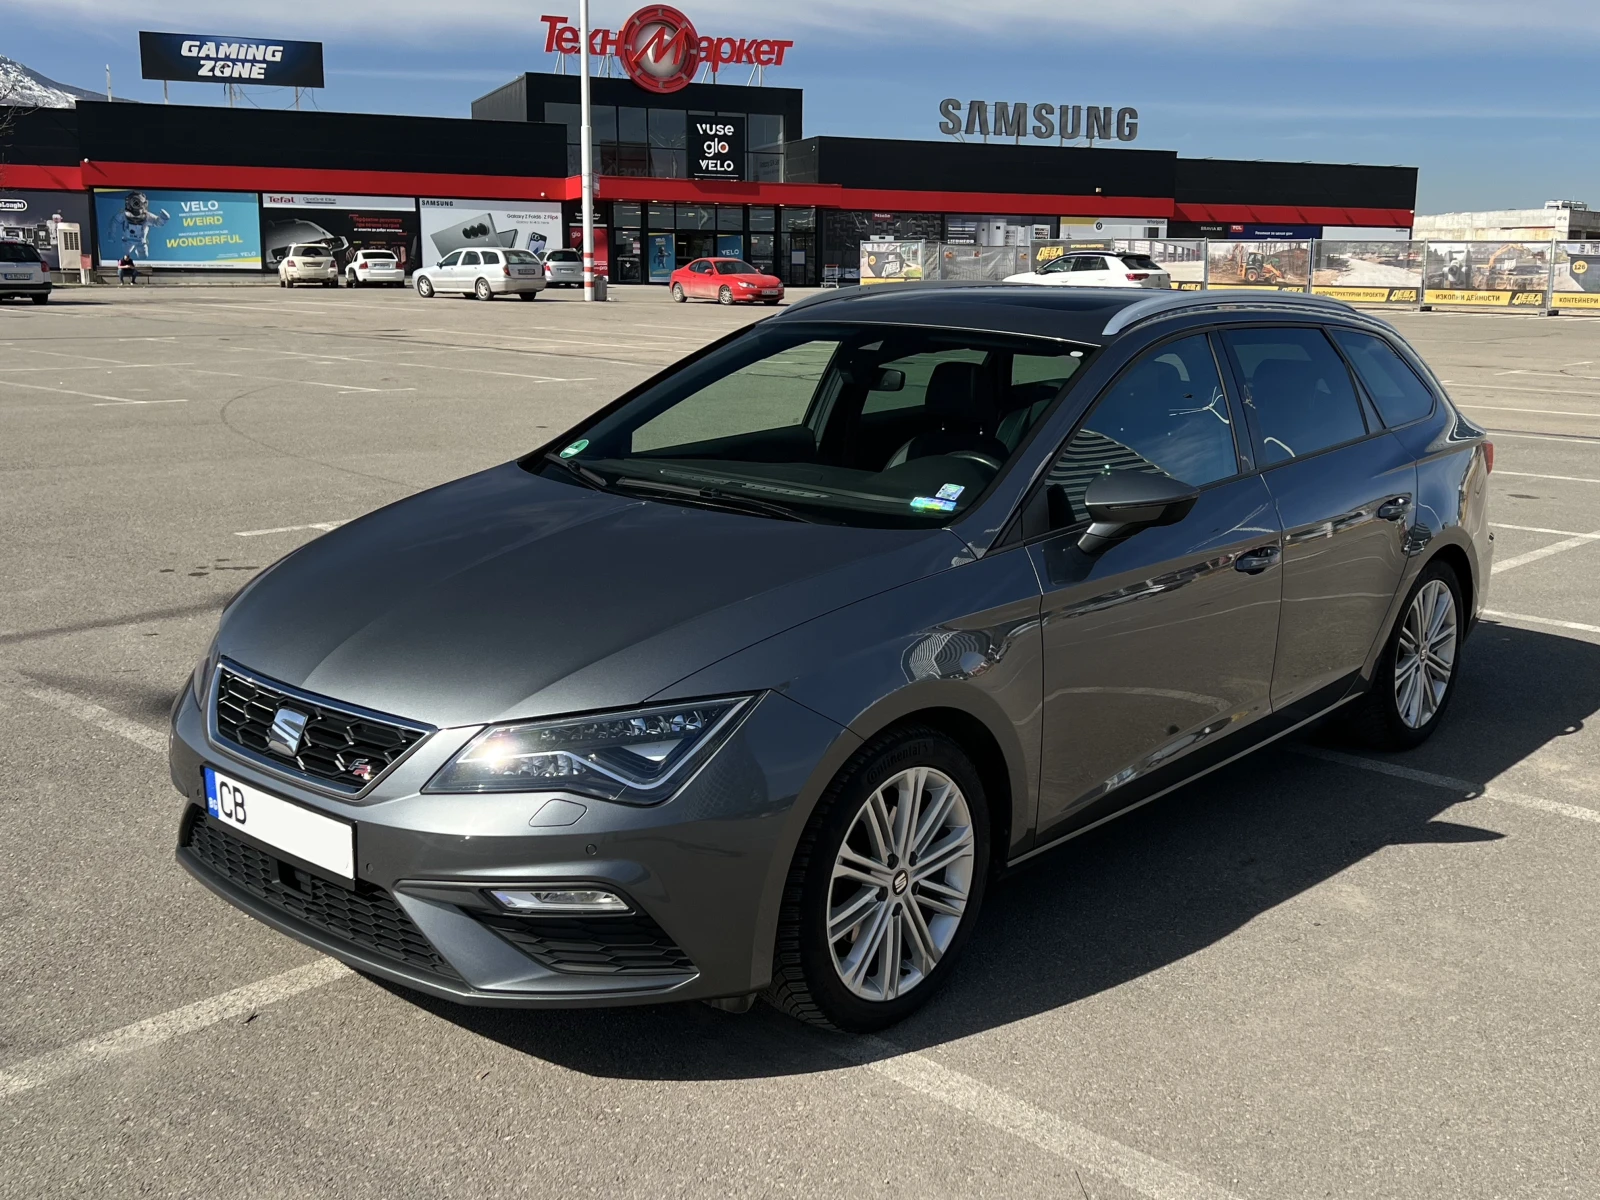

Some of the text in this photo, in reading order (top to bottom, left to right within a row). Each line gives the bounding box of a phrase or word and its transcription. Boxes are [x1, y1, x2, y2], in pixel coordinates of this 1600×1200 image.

[181, 40, 284, 62] GAMING
[197, 60, 267, 79] ZONE
[939, 98, 1138, 142] SAMSUNG
[696, 123, 735, 136] vuse
[703, 137, 729, 157] glo
[699, 159, 734, 171] VELO
[267, 195, 296, 204] Tefal
[421, 199, 454, 207] SAMSUNG
[181, 200, 218, 213] VELO
[183, 215, 223, 227] WEIRD
[166, 234, 243, 248] WONDERFUL
[1559, 296, 1599, 304] КОНТЕЙНЕРИ
[219, 781, 247, 825] CB
